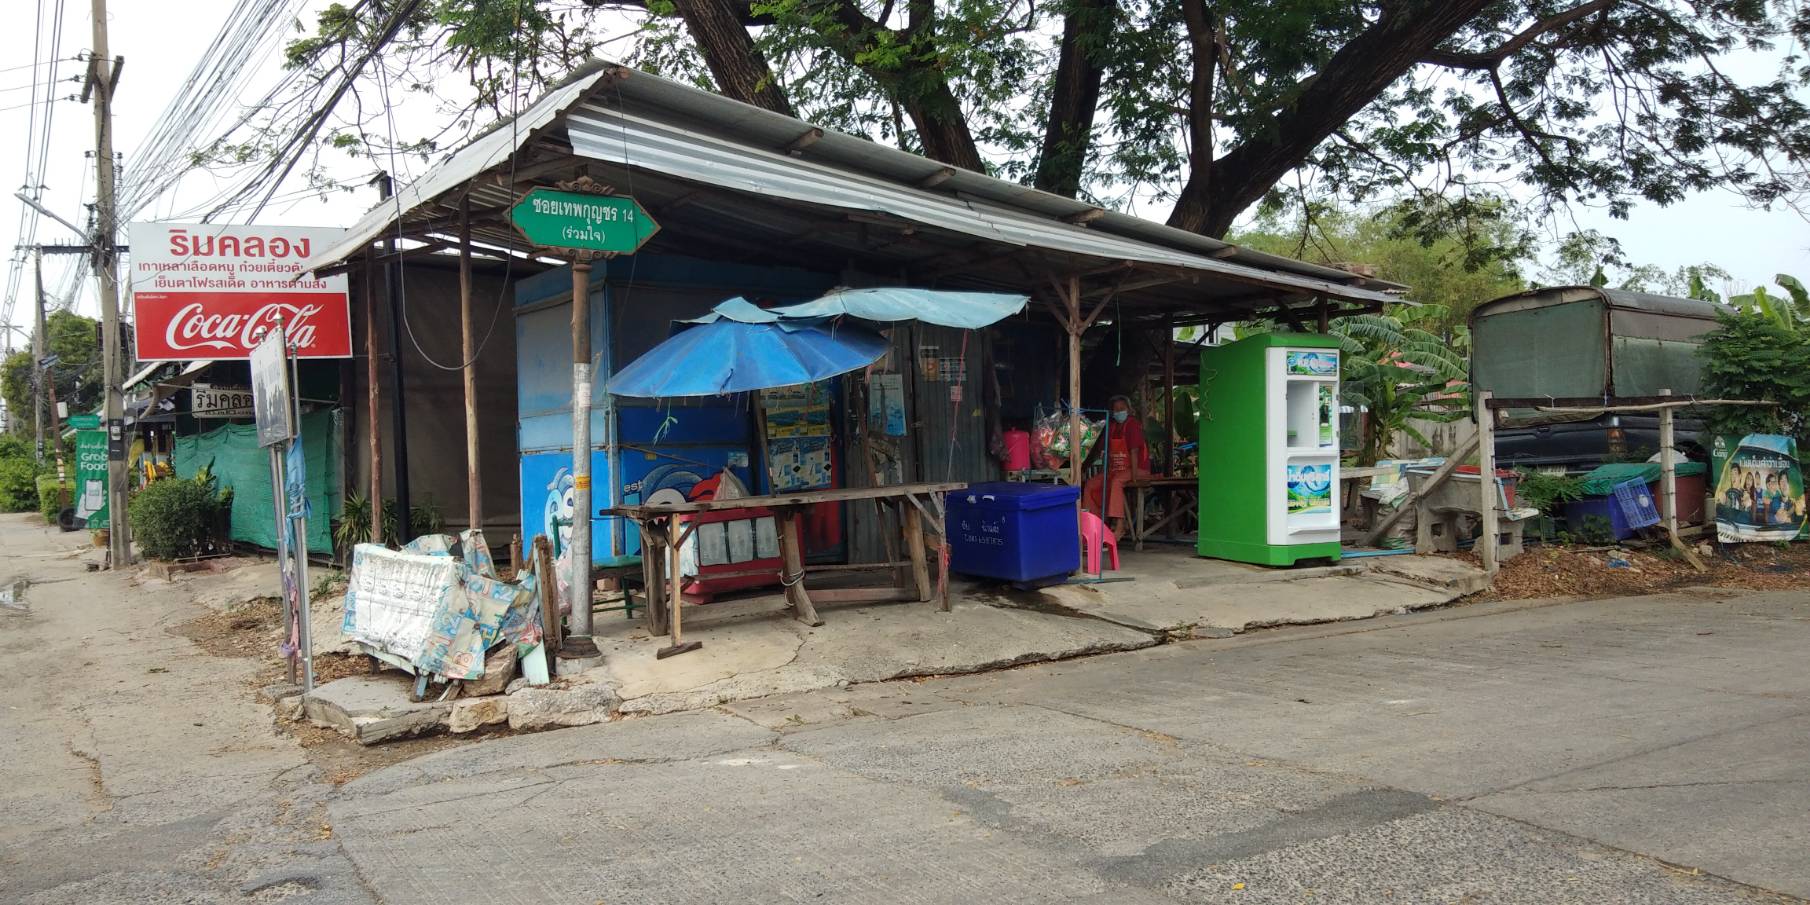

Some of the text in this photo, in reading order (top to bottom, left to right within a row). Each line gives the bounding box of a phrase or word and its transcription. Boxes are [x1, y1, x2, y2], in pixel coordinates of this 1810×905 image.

[532, 198, 634, 225] ซอยเทพกุญชร 14
[169, 229, 311, 259] ริมคลอง
[562, 225, 606, 244] (ร่วมใจ)
[138, 260, 235, 276] เกาเหลาเลือดหมู
[154, 274, 327, 289] เย็นตาโฟรสเด็ด อาหารตามสง
[166, 302, 325, 350] Coca-Cola
[196, 388, 254, 409] ริมคลอ
[624, 480, 643, 492] est
